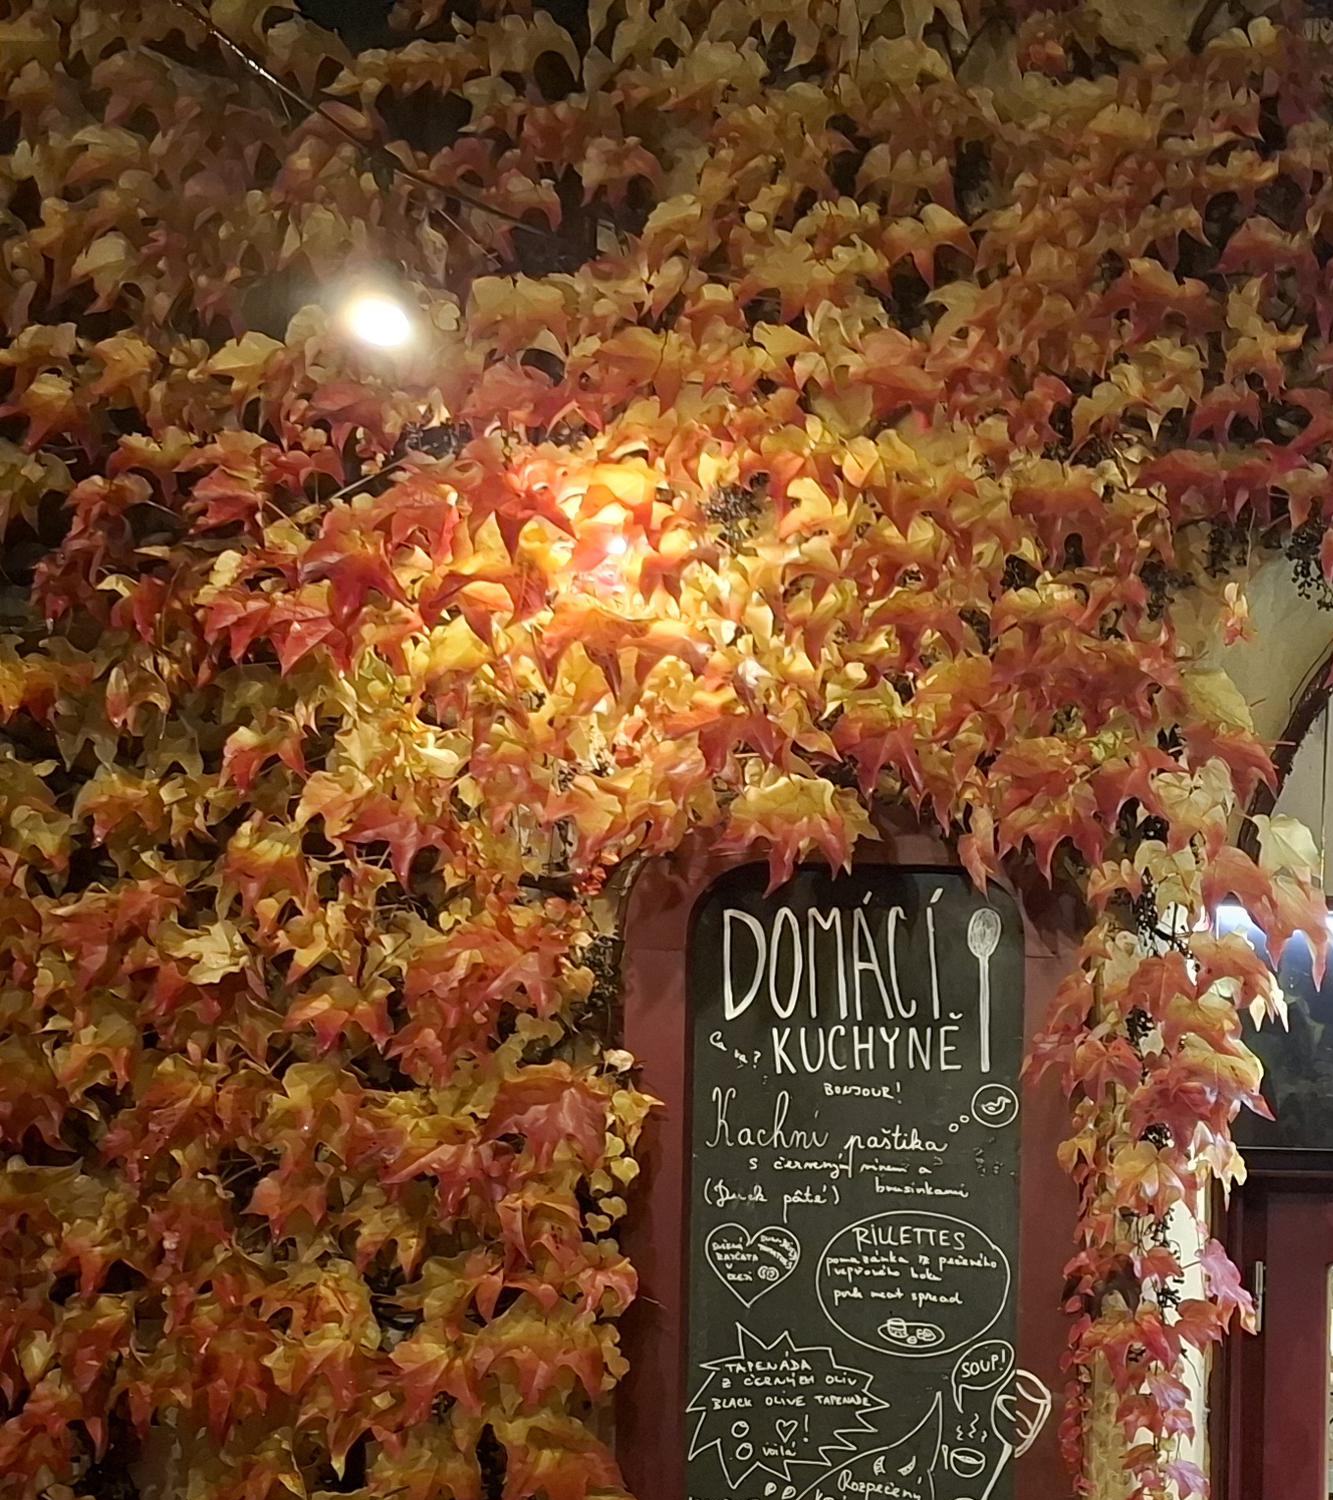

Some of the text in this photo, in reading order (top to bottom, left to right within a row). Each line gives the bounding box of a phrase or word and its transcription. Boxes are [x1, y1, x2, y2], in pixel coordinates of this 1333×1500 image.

[722, 888, 944, 1021] DOMÁCÍ
[771, 1012, 963, 1074] KUCHYNĚ
[706, 1086, 948, 1179] Kachní paštika
[725, 1351, 813, 1374] TAPENÁDA
[961, 1349, 1007, 1378] SOUP!
[711, 1397, 753, 1411] BLACK
